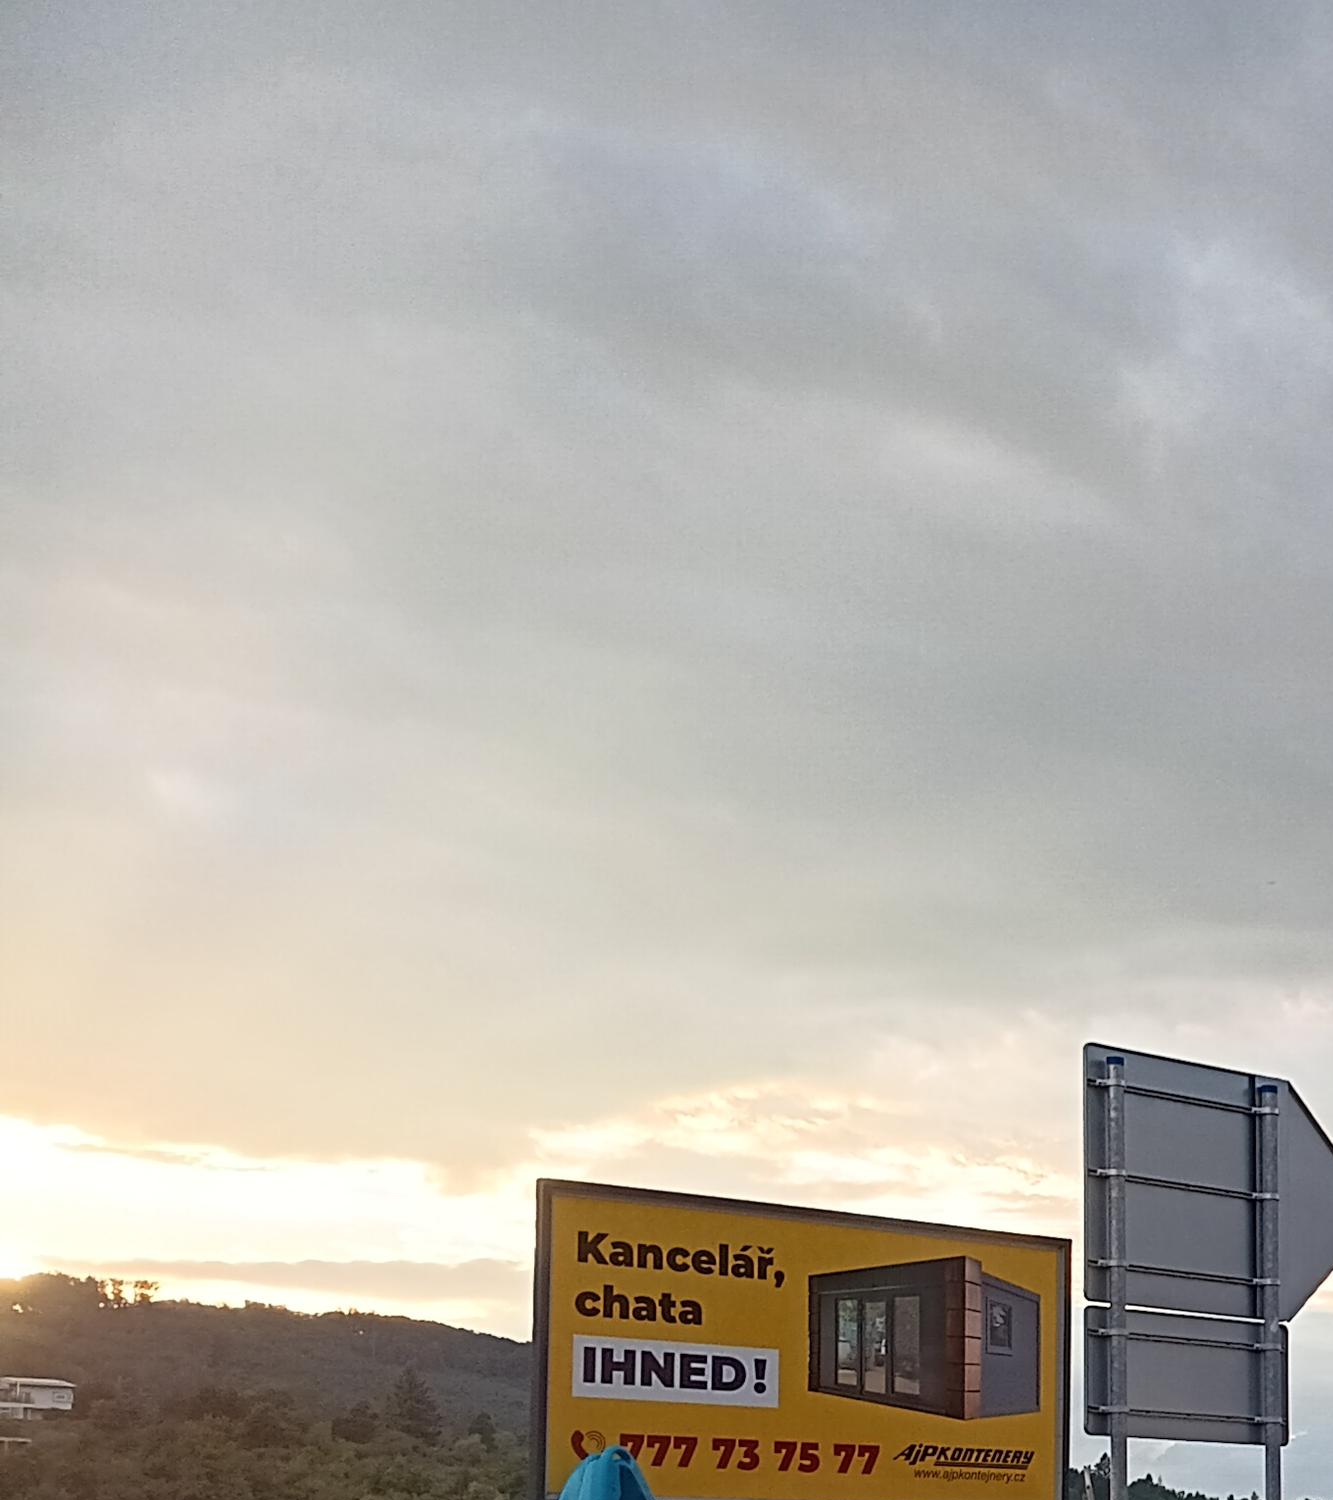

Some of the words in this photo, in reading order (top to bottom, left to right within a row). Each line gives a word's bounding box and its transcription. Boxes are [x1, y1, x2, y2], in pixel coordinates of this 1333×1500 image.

[576, 1229, 785, 1288] Kancelář,
[574, 1285, 703, 1326] chata
[582, 1345, 768, 1395] IHNED!
[619, 1433, 698, 1468] 777
[711, 1437, 760, 1471] 73
[773, 1440, 821, 1473] 75
[833, 1444, 880, 1475] 77
[913, 1468, 1026, 1485] www.ajpkontejnery.cz
